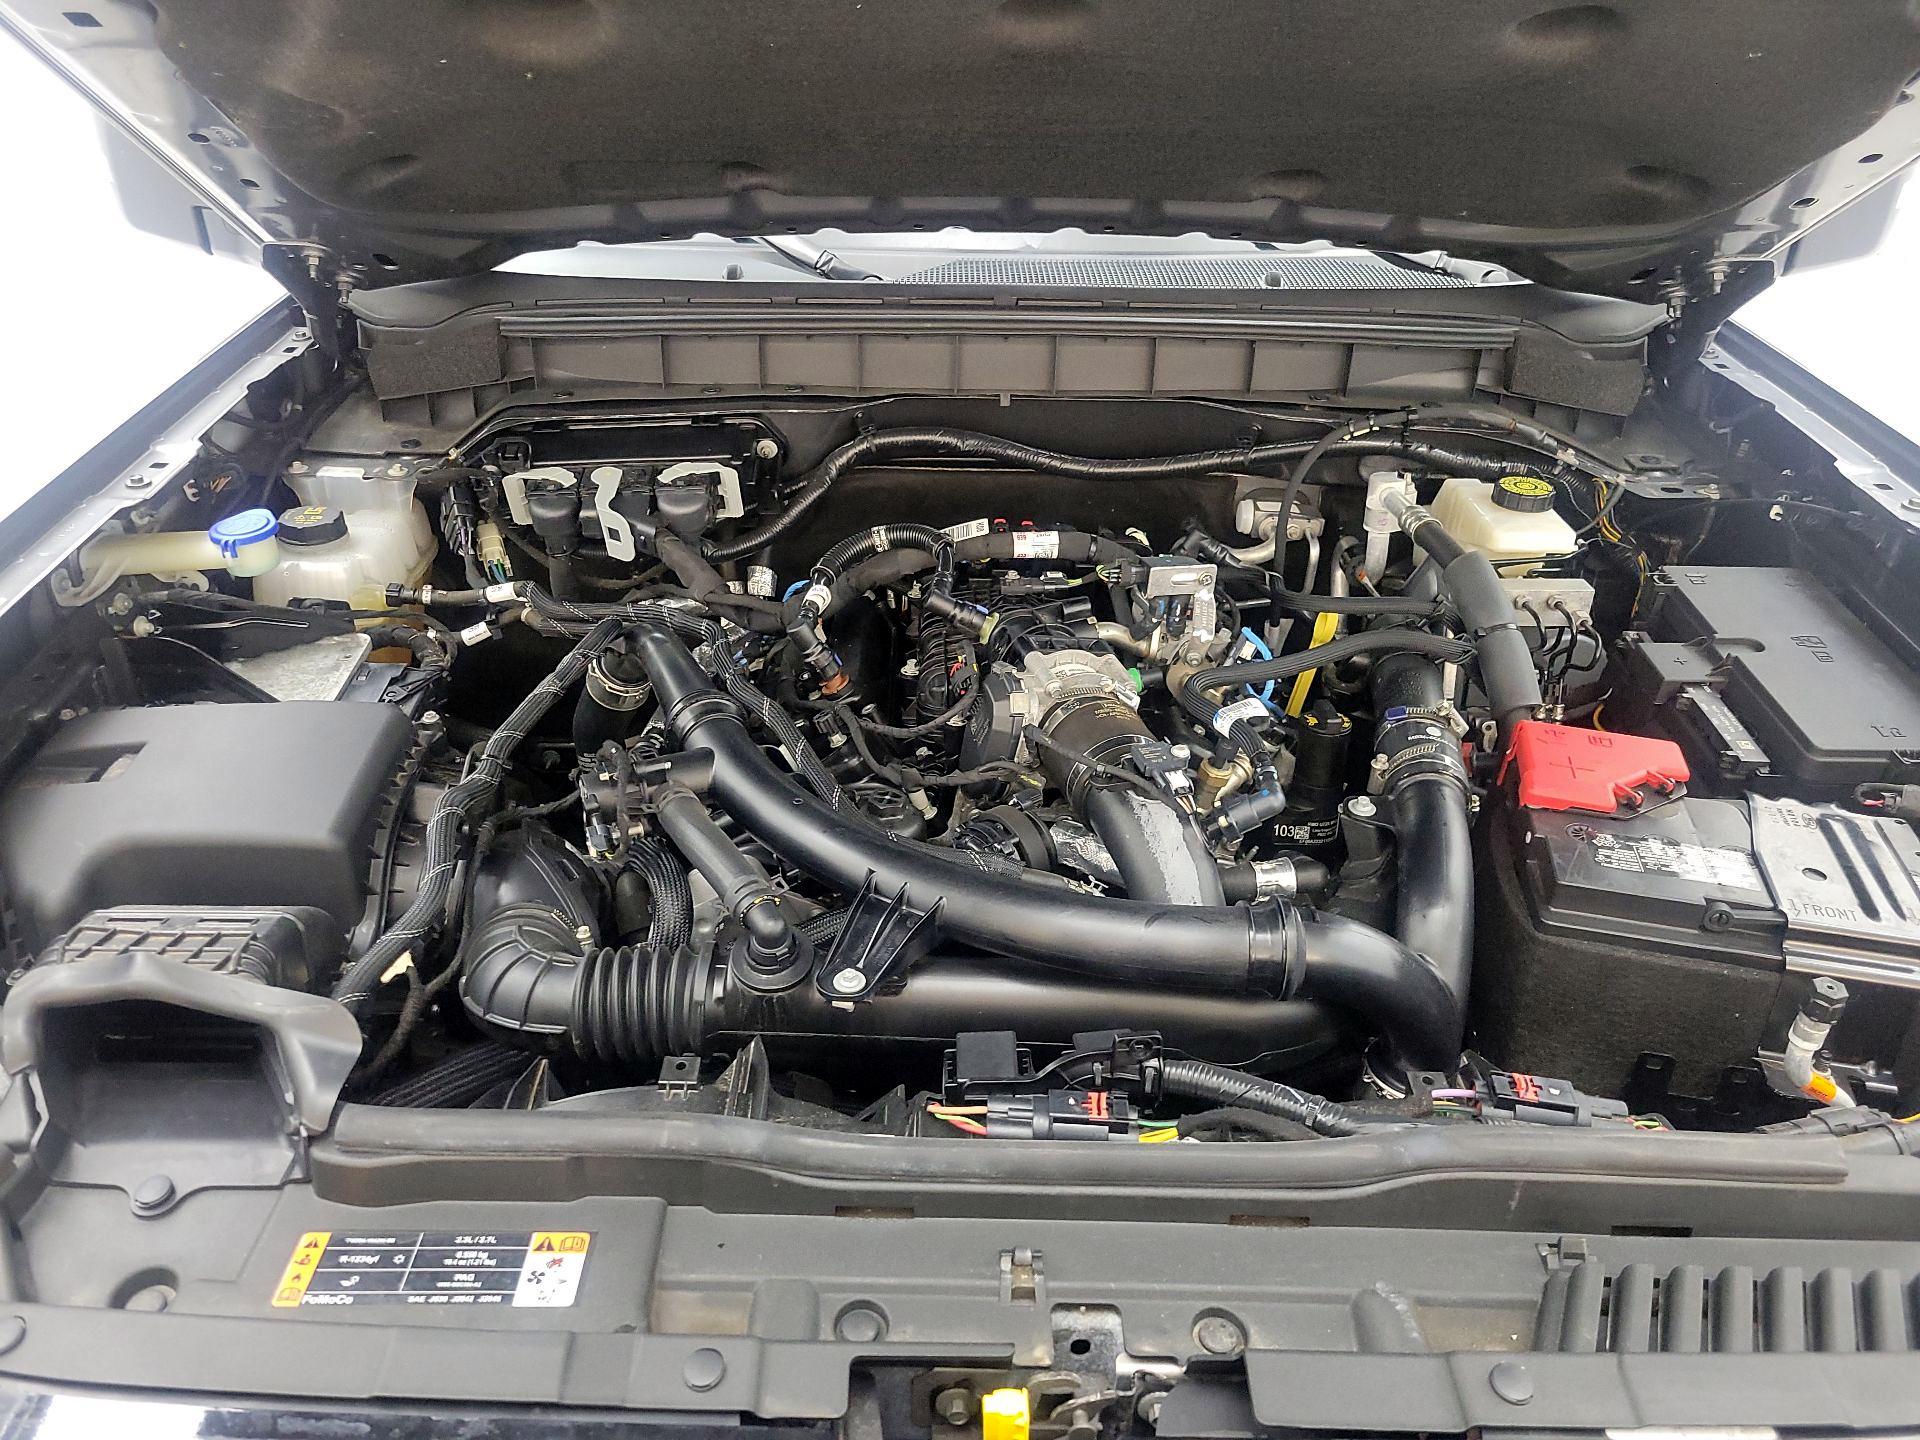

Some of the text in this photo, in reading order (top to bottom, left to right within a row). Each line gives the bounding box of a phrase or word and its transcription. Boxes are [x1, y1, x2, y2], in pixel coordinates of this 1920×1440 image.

[1273, 823, 1295, 837] 103
[1803, 903, 1858, 922] FRONT
[301, 1294, 354, 1304] FoMoCo
